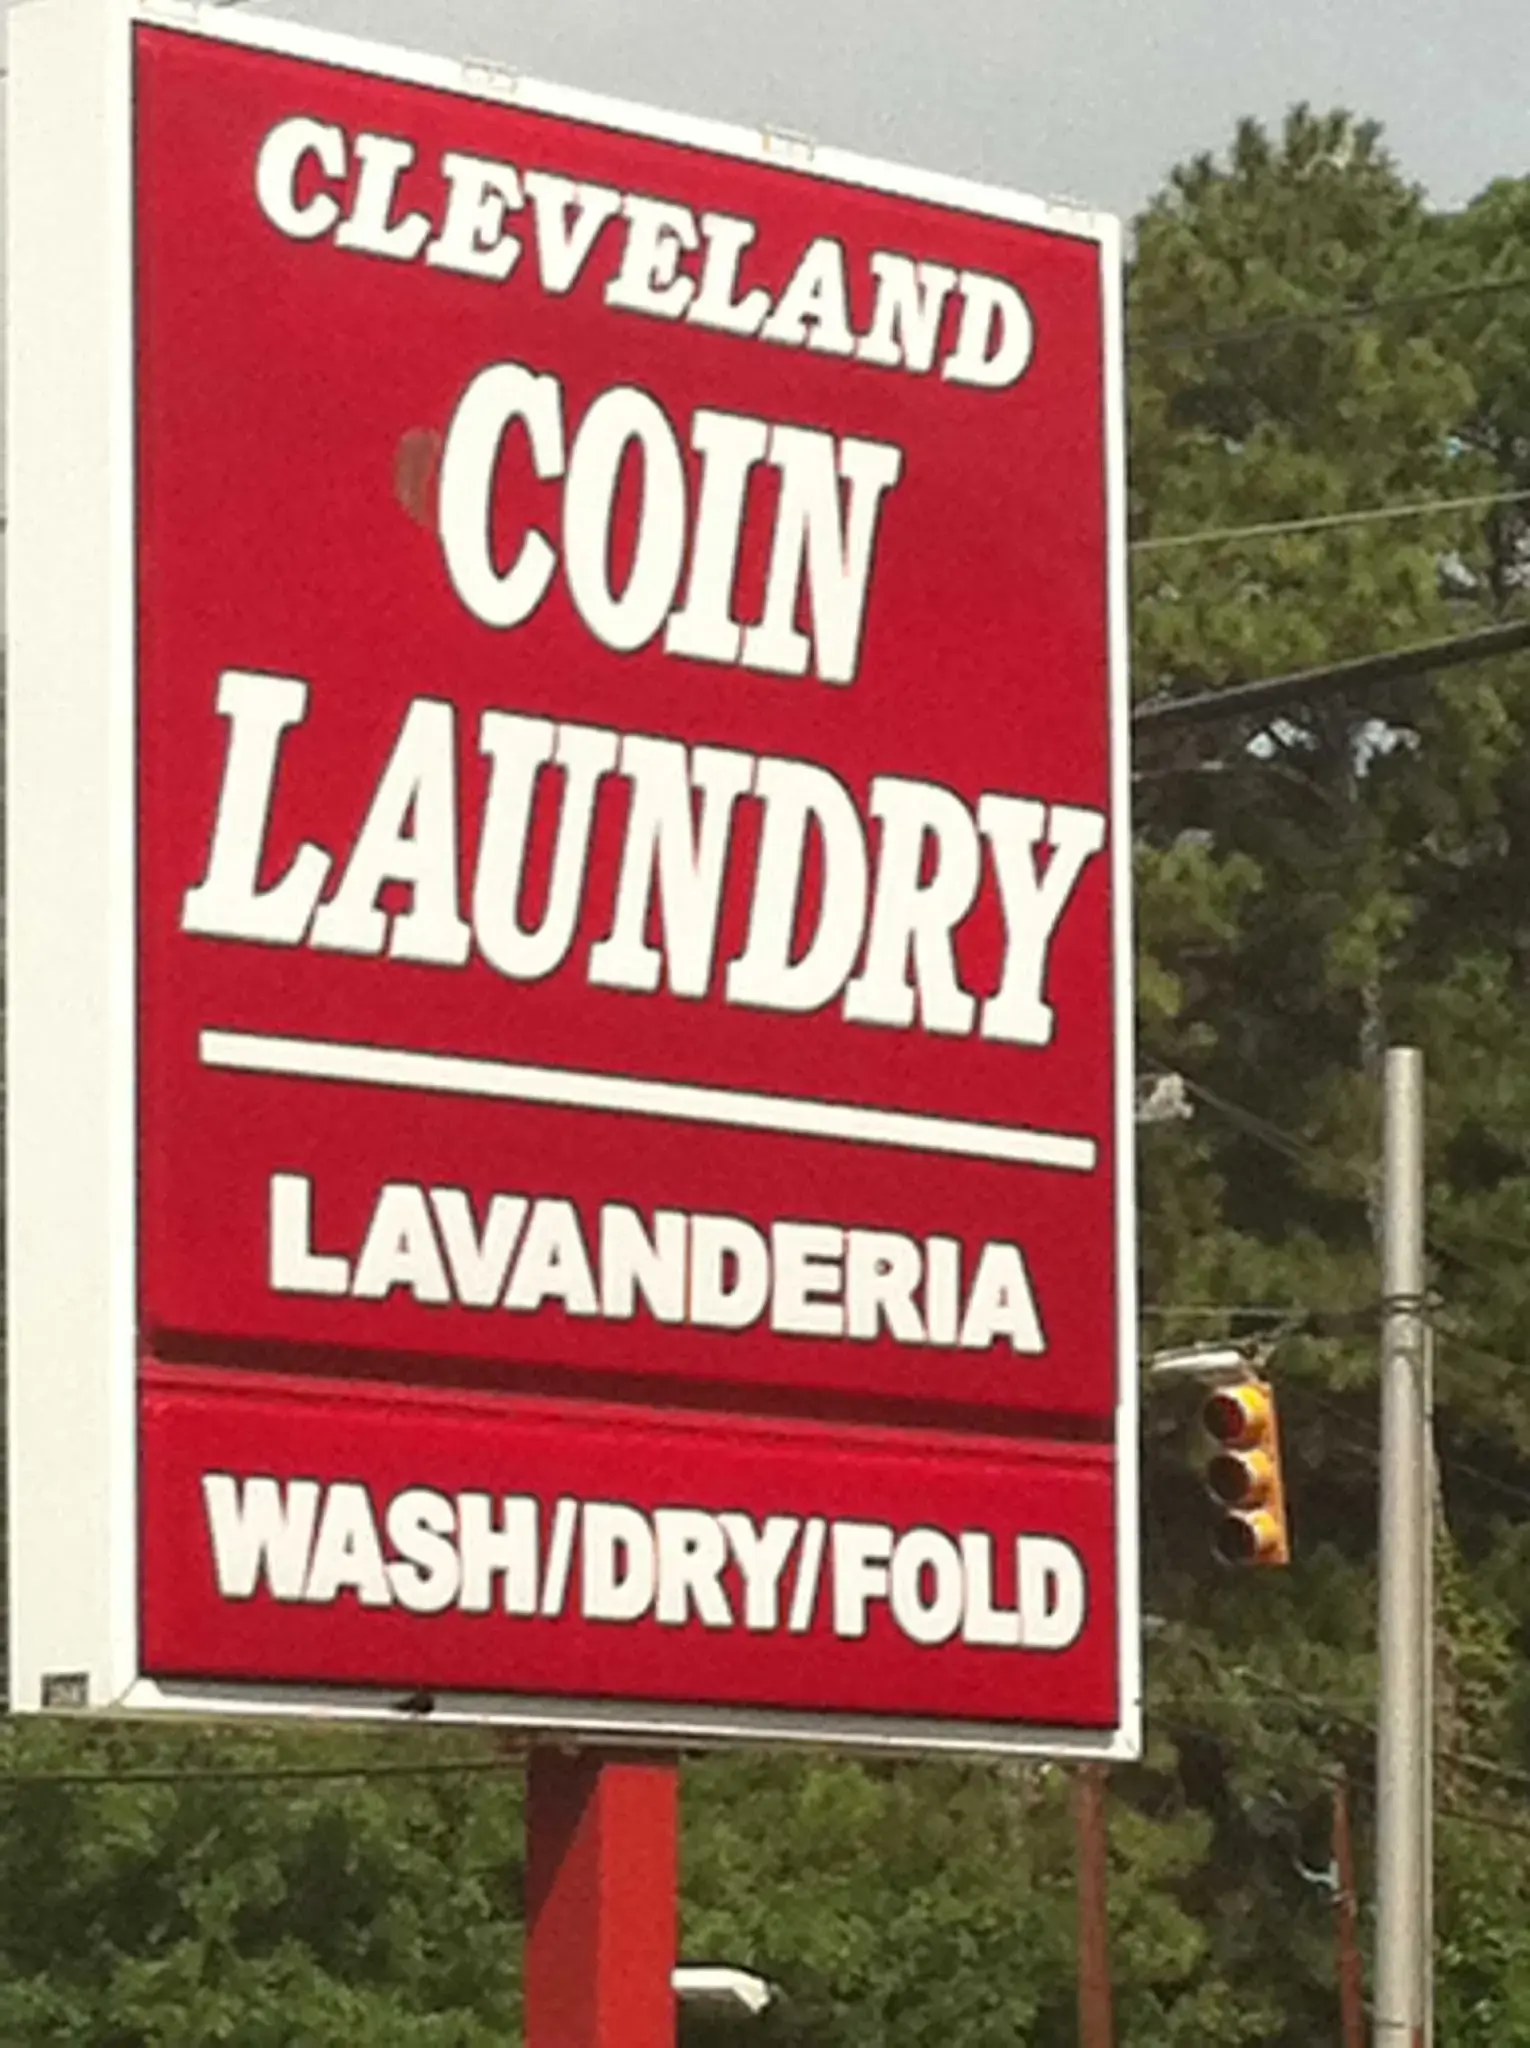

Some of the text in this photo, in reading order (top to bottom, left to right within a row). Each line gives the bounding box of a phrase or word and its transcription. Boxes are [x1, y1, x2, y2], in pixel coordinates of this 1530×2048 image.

[255, 117, 1032, 388] CLEVELAND
[437, 363, 902, 685] COIN
[180, 670, 1106, 1046] LAUNDRY
[269, 1173, 1045, 1354] LAVANDERIA
[202, 1474, 1085, 1649] WASH/DRY/FOLD
